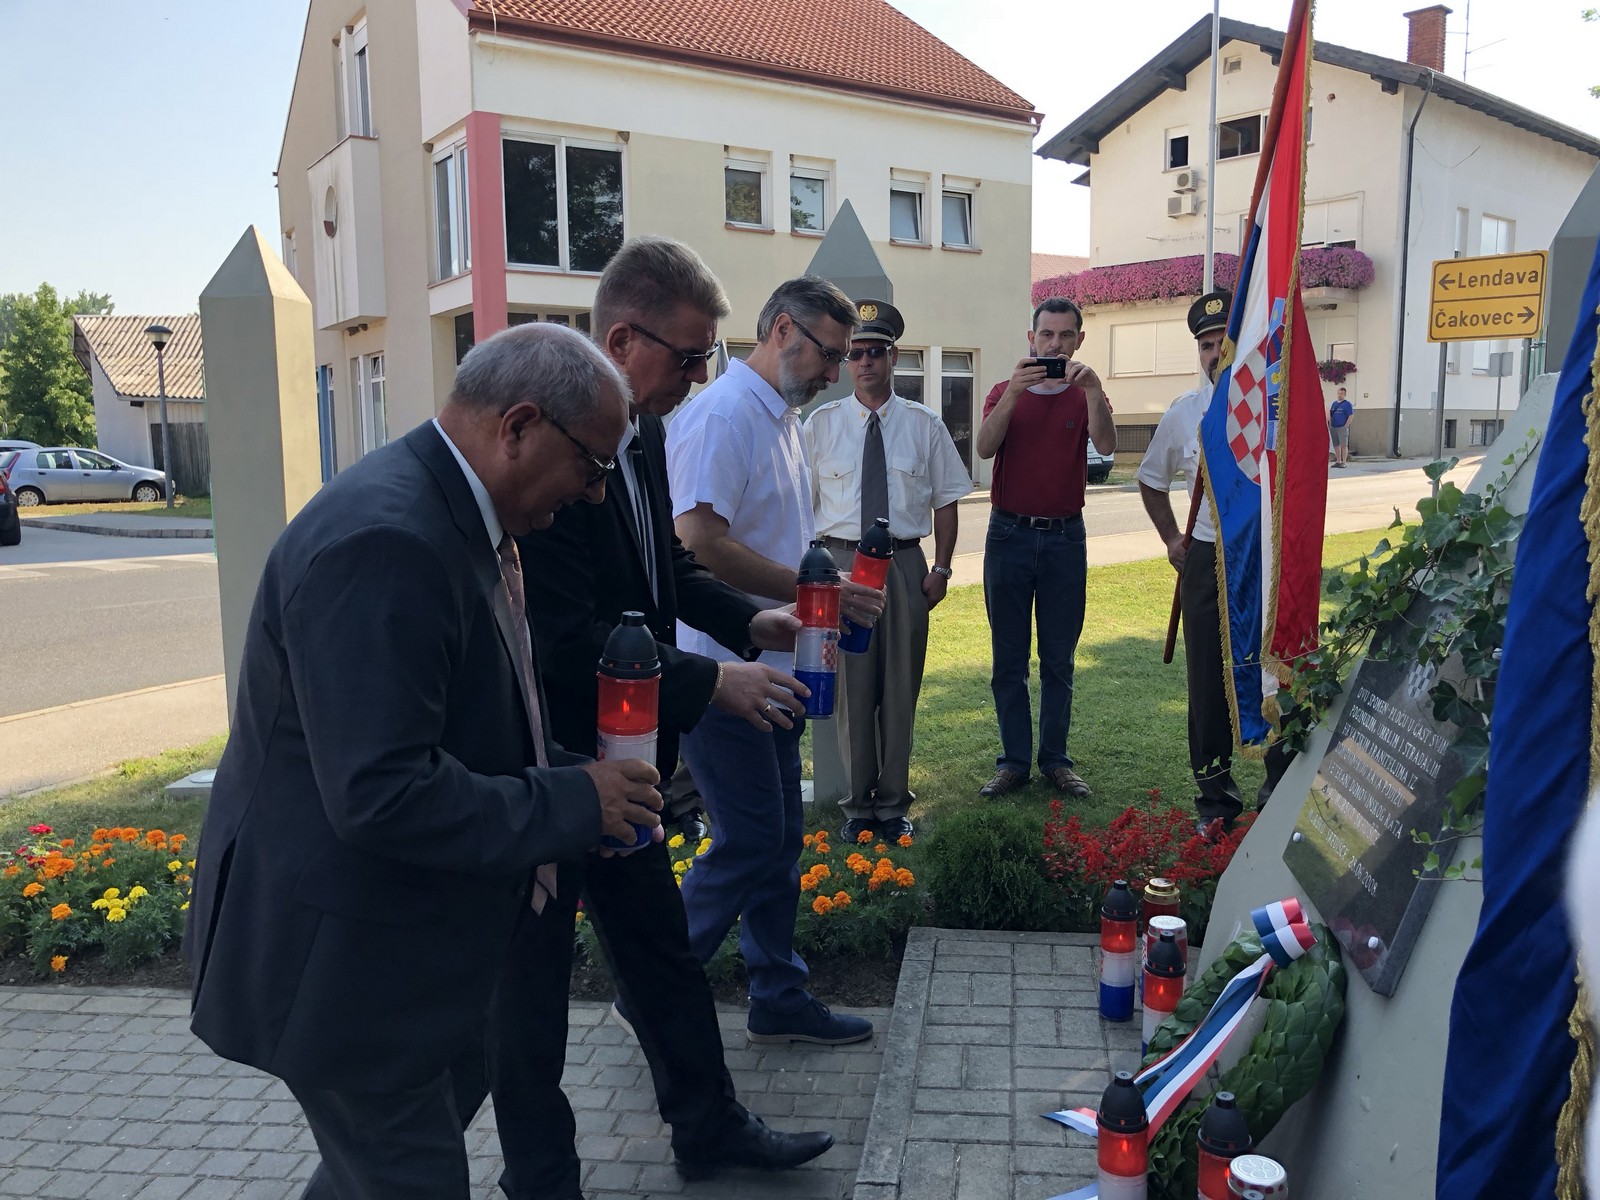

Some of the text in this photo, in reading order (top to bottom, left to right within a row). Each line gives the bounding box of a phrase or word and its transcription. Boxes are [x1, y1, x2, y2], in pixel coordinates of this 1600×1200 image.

[1458, 269, 1539, 288] Lendava
[1435, 308, 1513, 329] Čakovec
[1355, 685, 1370, 704] OVU
[1374, 722, 1401, 749] UMRLIM
[1400, 740, 1442, 779] STRADALIM
[1382, 811, 1406, 840] RATA
